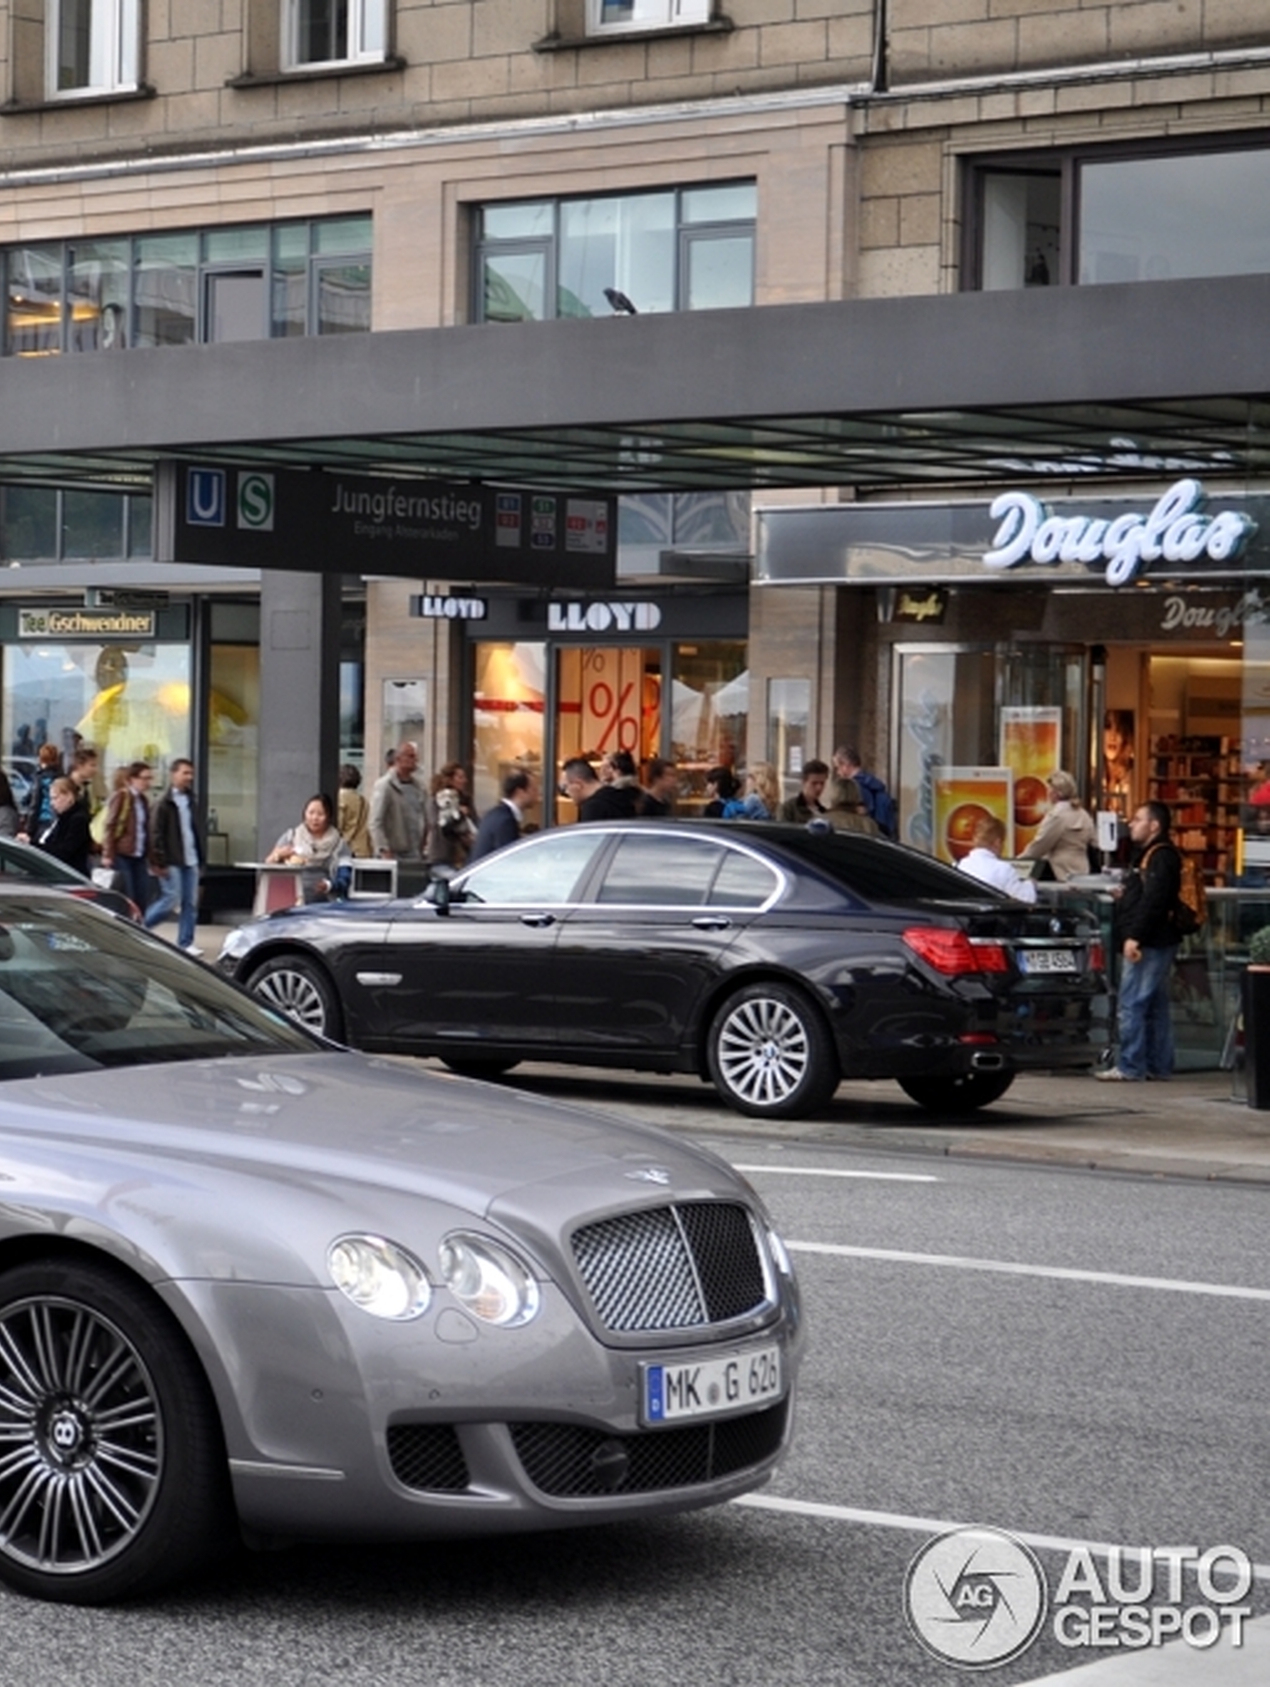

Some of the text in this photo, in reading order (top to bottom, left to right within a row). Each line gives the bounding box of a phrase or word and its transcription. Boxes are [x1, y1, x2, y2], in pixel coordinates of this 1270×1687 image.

[193, 473, 268, 525] U S
[332, 484, 481, 529] Jungfernstieg
[982, 478, 1254, 585] Douglas
[21, 612, 151, 633] Tee Gschwendner
[422, 596, 485, 618] LLOYD
[548, 602, 661, 631] LLOYD
[665, 1351, 777, 1411] MK G 626
